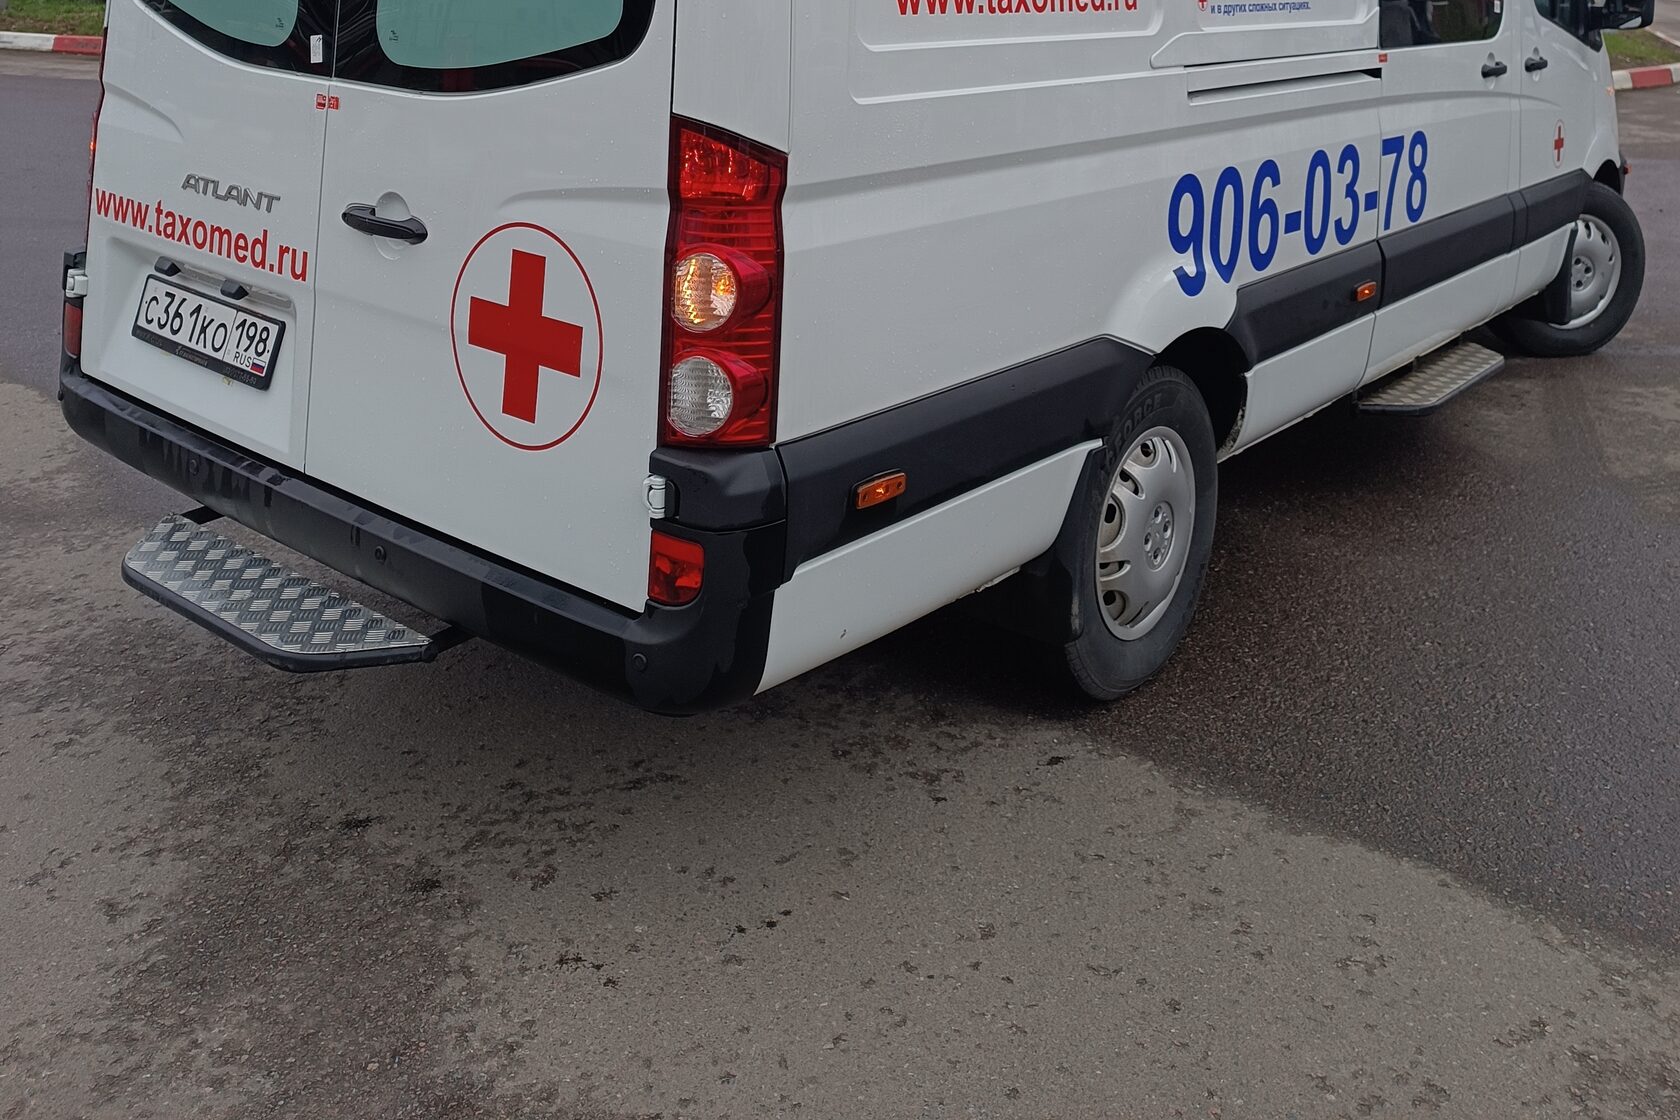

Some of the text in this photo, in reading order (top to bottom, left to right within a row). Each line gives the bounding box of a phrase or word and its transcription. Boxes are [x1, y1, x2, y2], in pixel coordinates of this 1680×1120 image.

[1210, 1, 1311, 16] и в других сложных ситуациях.
[181, 173, 281, 213] ATLANT
[1168, 130, 1428, 297] 906-03-78
[95, 188, 308, 281] www.taxomed.ru
[235, 318, 270, 357] 198
[233, 351, 252, 368] RUS
